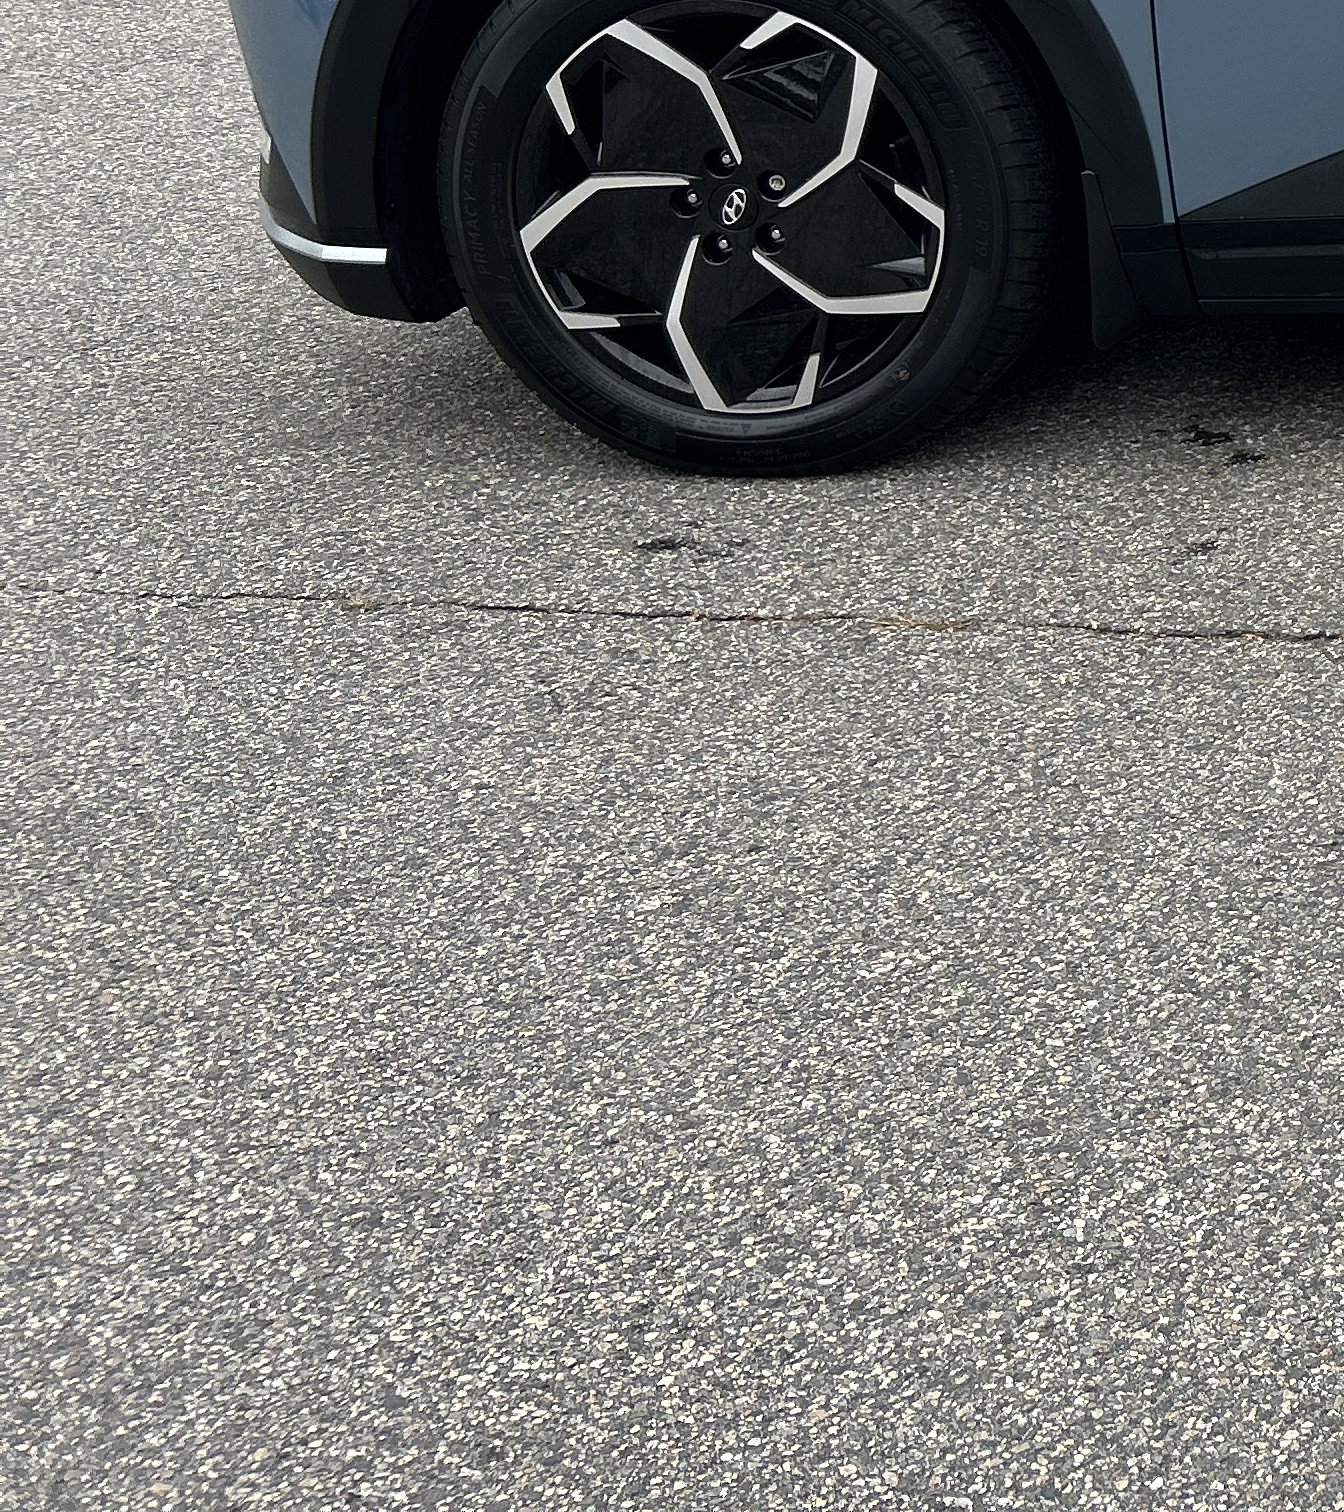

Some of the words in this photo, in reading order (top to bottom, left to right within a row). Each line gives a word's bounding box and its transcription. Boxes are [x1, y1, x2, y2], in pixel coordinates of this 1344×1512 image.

[839, 0, 965, 124] MICHELIN
[466, 101, 488, 156] SEASON
[463, 159, 475, 184] ALL
[463, 191, 492, 276] PRIMACY
[974, 239, 989, 258] 19
